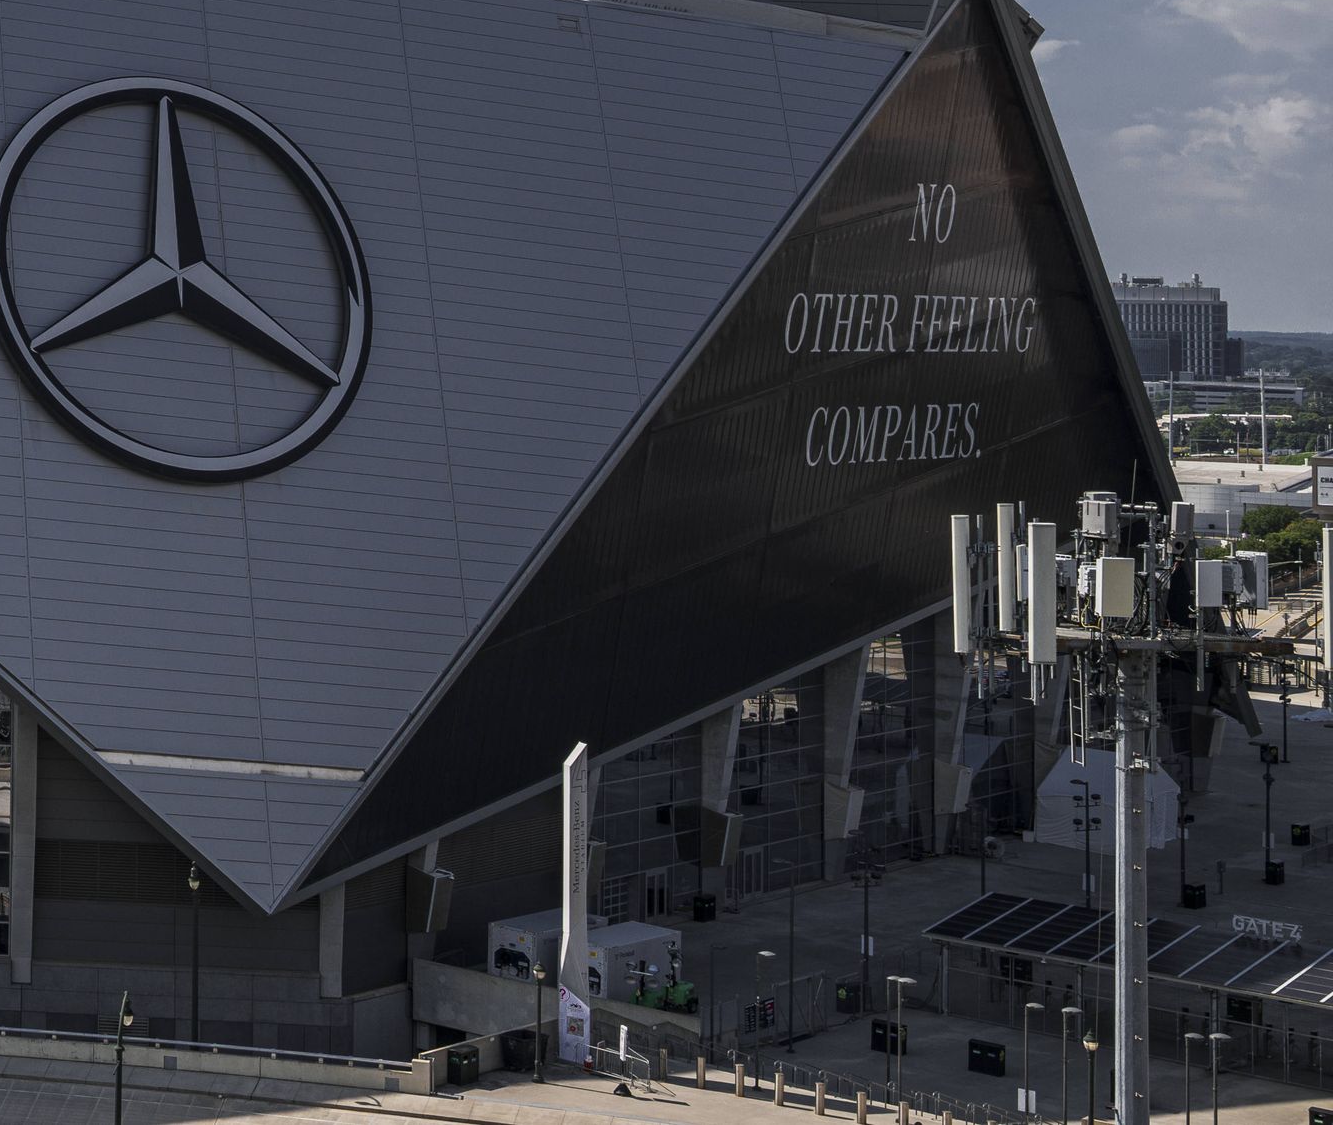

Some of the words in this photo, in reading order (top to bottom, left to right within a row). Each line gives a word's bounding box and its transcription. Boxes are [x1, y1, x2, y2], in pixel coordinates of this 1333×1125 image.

[908, 183, 956, 243] NO
[784, 292, 898, 354] OTHER
[906, 295, 1037, 353] FEELING
[805, 402, 982, 467] COMPARES.
[572, 800, 580, 894] Mercedes-Benz
[1233, 915, 1284, 938] GATE
